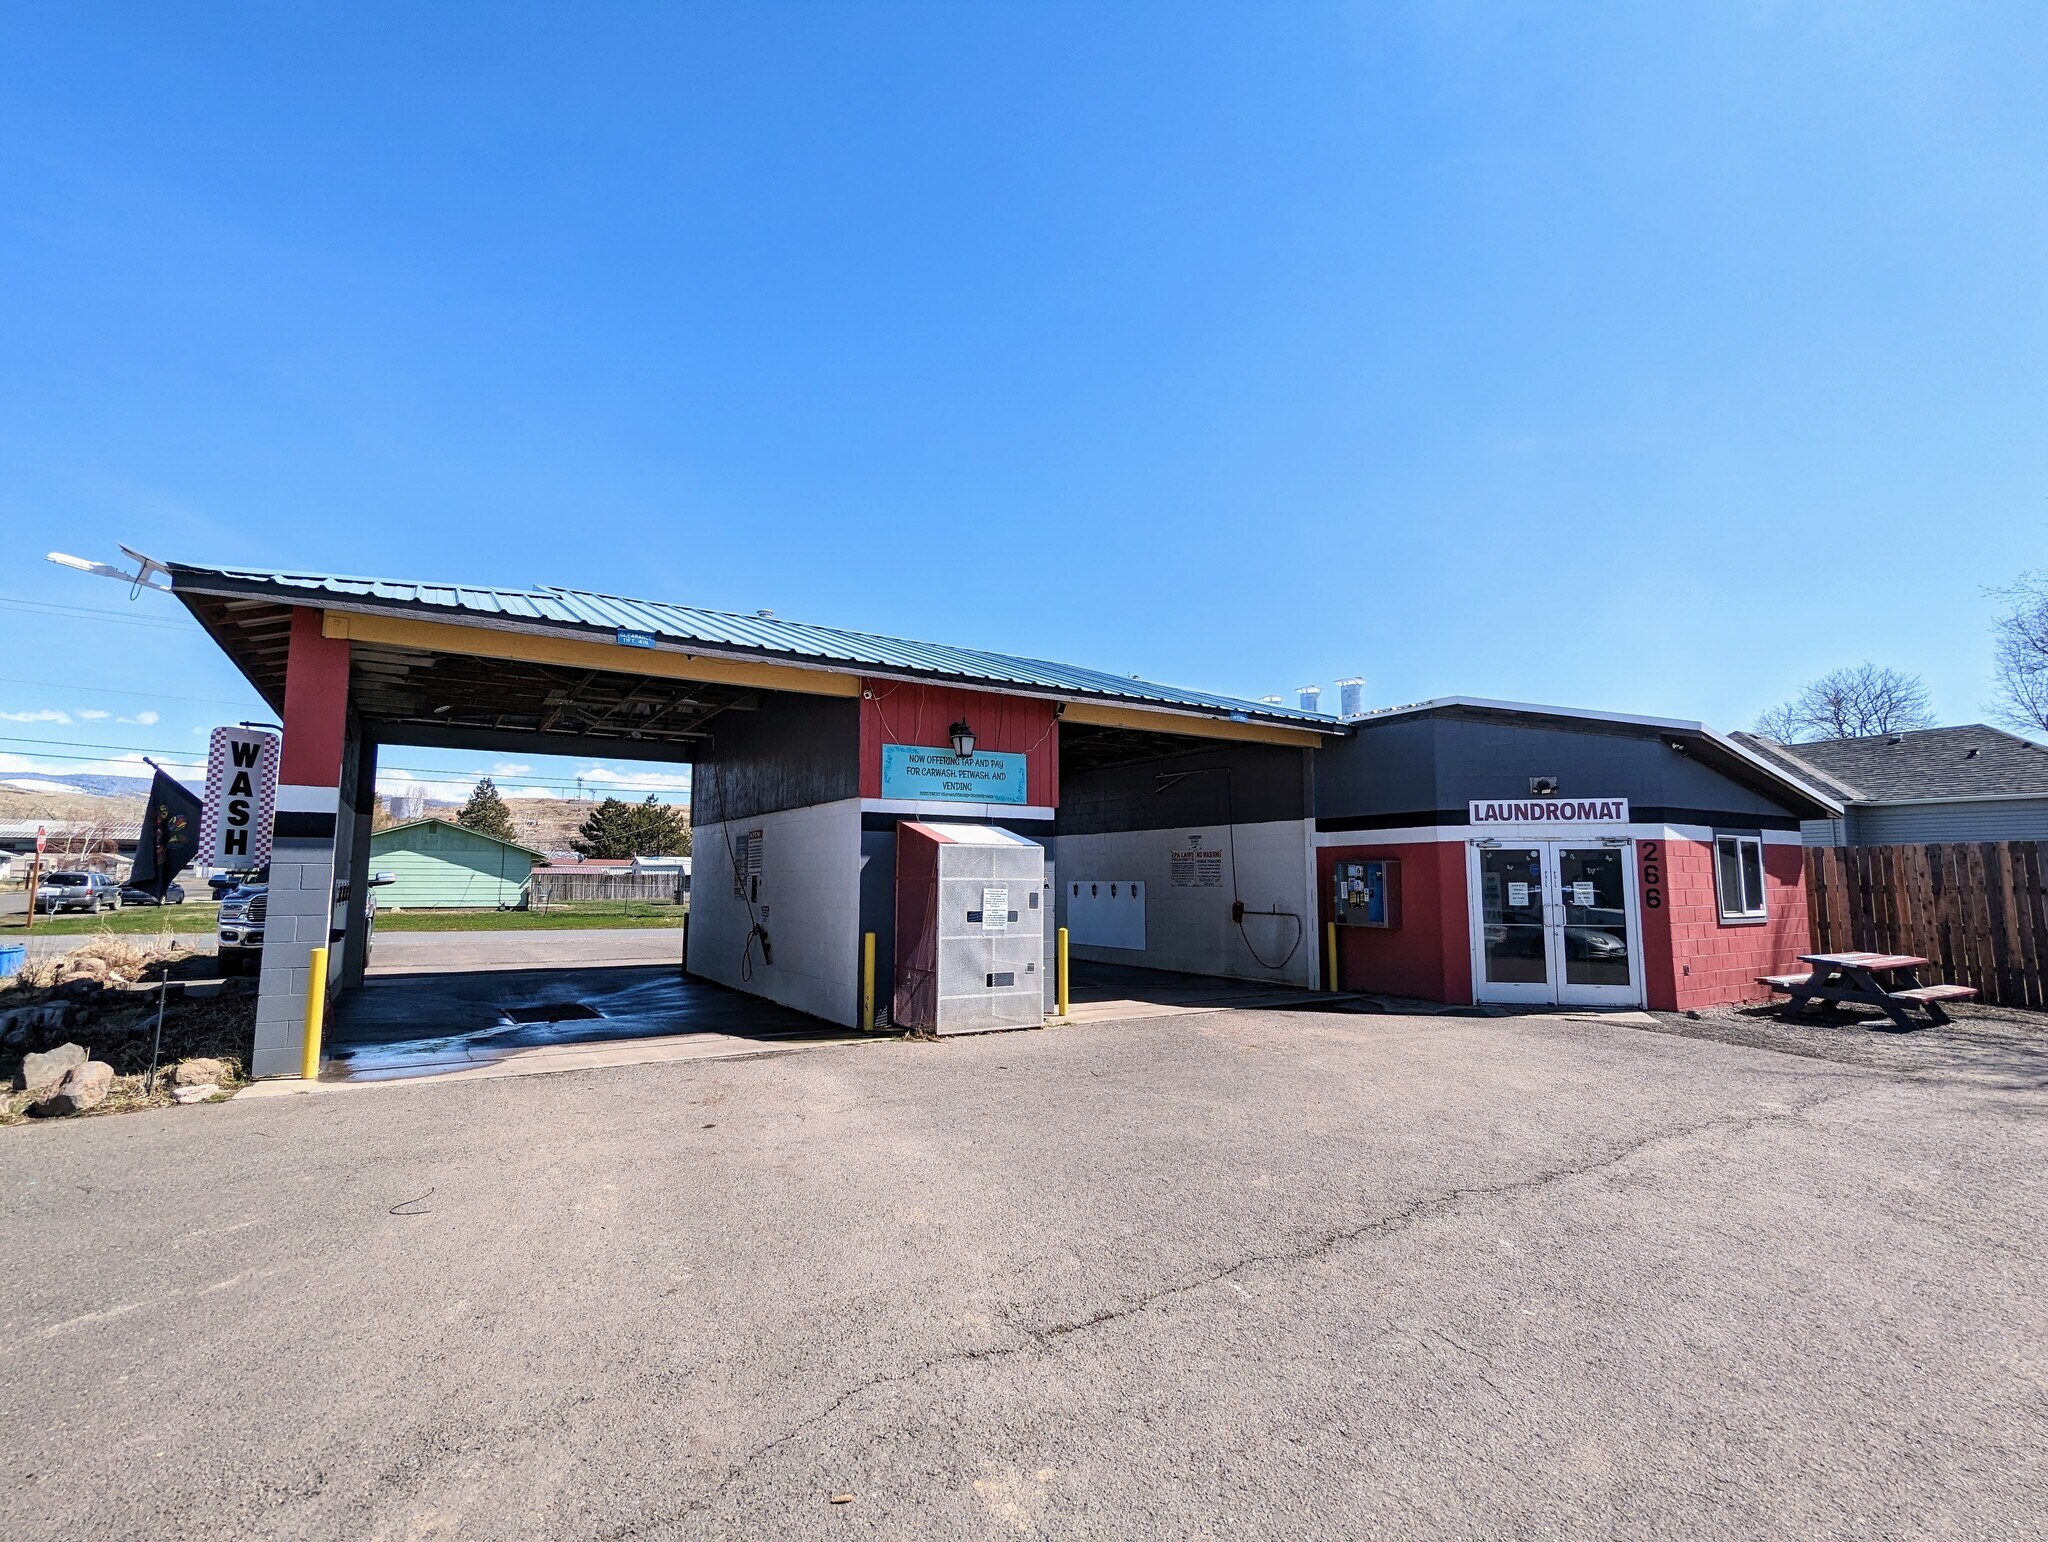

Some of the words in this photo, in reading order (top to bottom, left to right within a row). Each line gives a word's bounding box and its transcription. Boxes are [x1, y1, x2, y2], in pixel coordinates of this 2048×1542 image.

[909, 754, 925, 764] NOW
[927, 755, 960, 767] OFFERING
[961, 757, 974, 767] TAP
[975, 758, 990, 768] AND
[991, 759, 1004, 770] PAY
[906, 767, 920, 776] FOR
[992, 771, 1006, 781] AND
[942, 781, 972, 791] VENDING
[224, 741, 261, 856] WASH
[1474, 801, 1623, 821] LAUNDROMAT
[1642, 841, 1661, 909] 266
